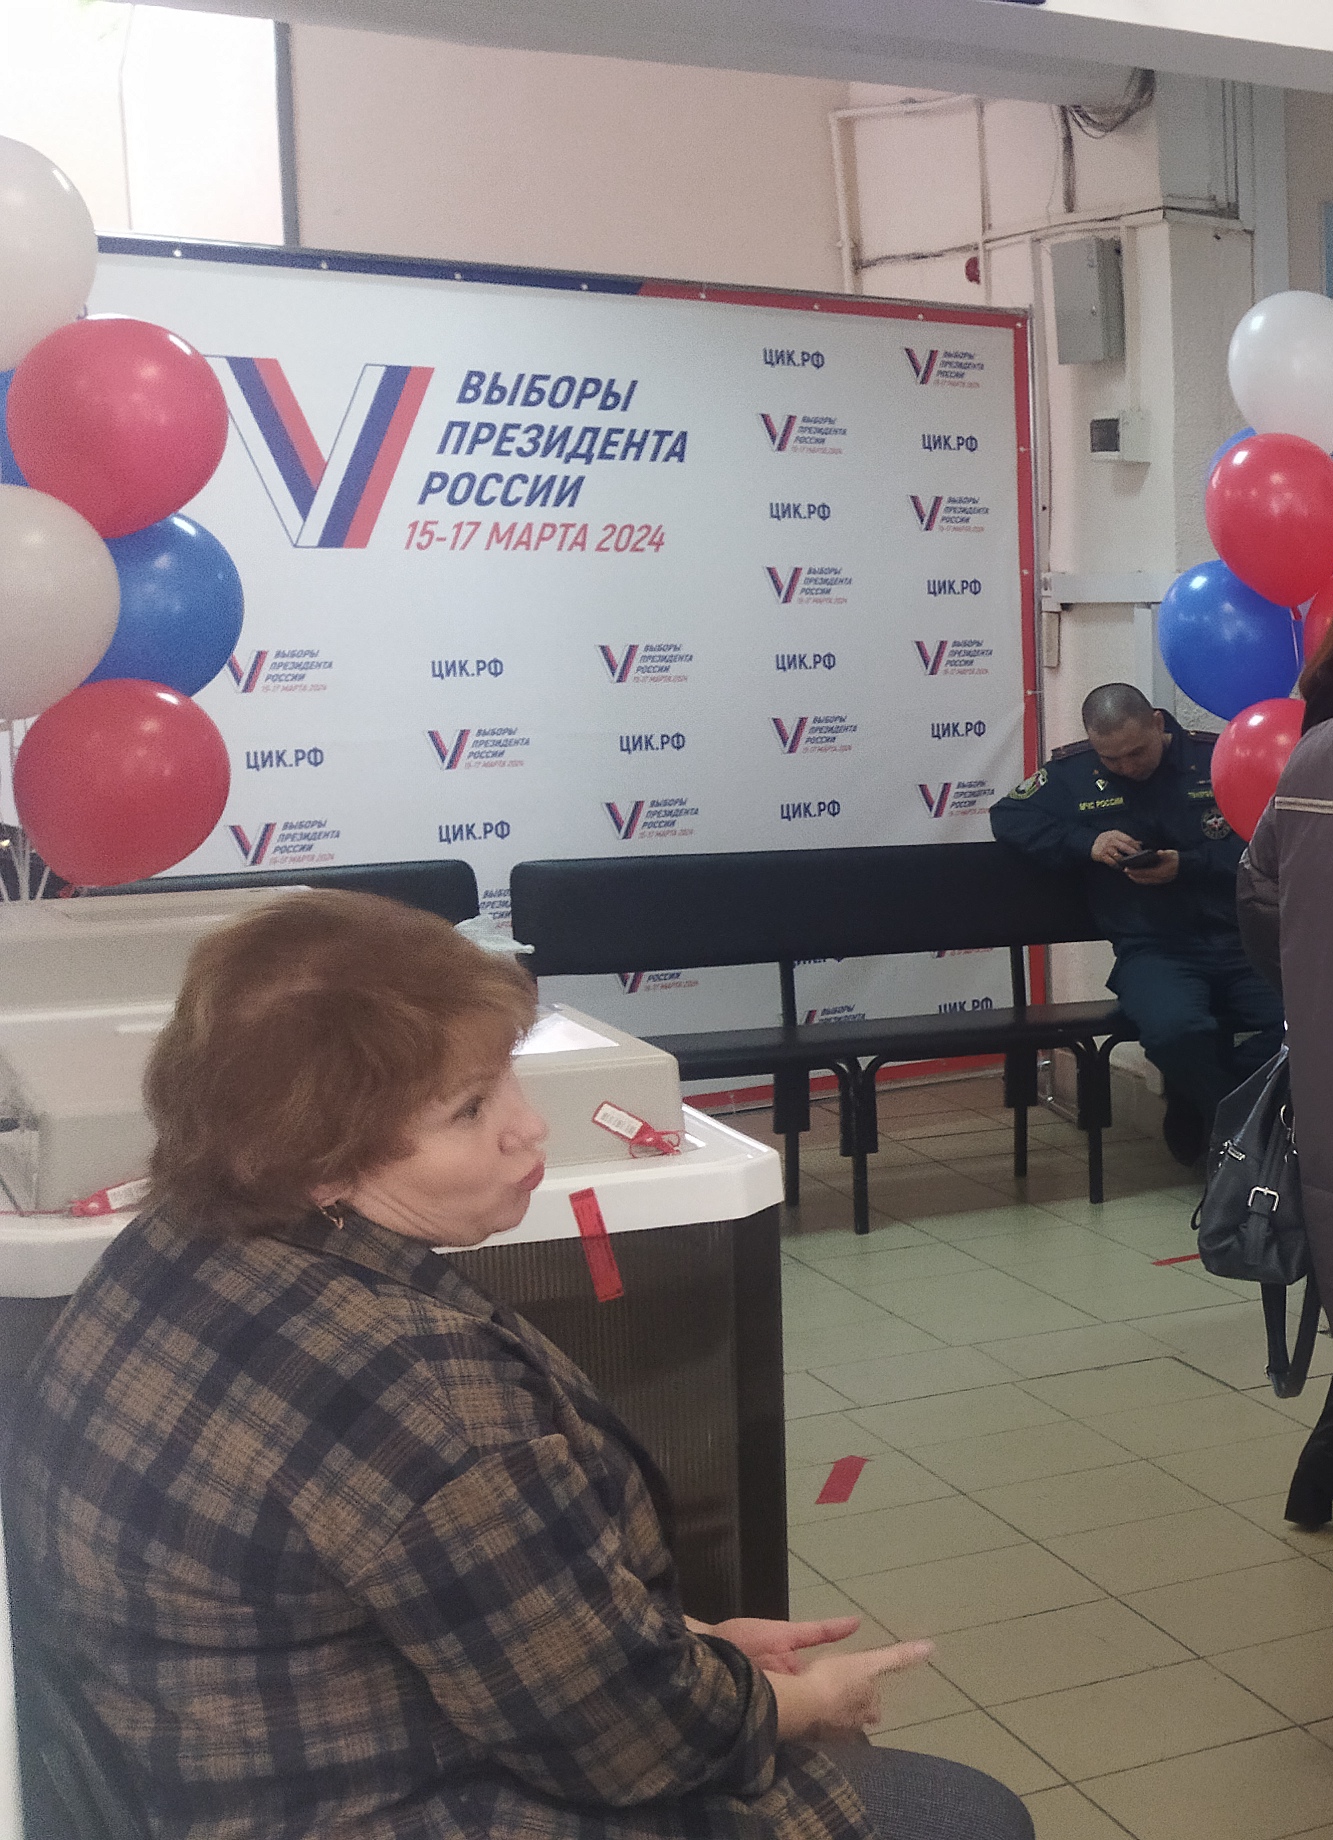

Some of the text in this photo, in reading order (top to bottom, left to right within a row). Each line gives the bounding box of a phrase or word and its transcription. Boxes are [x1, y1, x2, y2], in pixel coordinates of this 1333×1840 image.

[763, 348, 825, 369] ЦИК.РФ
[456, 370, 638, 412] ВЫБОРЫ
[437, 421, 688, 464] ПРЕЗИДЕНТА
[922, 434, 978, 452] ЦИК.РФ
[418, 471, 584, 508] РОССИИ
[769, 502, 831, 521] ЦИК.РФ
[404, 520, 665, 553] 15-17 МАРТА 2024
[926, 578, 982, 597] ЦИК.РФ
[274, 649, 319, 659] ВЫБОРЫ
[643, 643, 683, 652] ВЫБОРЫ
[269, 661, 333, 671] ПРЕЗИДЕНТА
[640, 654, 693, 664] ПРЕЗИДЕНТА
[775, 652, 836, 672] ЦИК.РФ
[265, 673, 306, 683] РОССИИ
[431, 658, 504, 680] ЦИК.РФ
[636, 665, 671, 674] РОССИИ
[476, 727, 518, 737] ВЫБОРЫ
[931, 720, 987, 740] ЦИК.РФ
[471, 737, 530, 749] ПРЕЗИДЕНТА
[619, 732, 686, 755] ЦИК.РФ
[245, 747, 325, 772] ЦИК.РФ
[467, 749, 505, 760] РОССИИ
[649, 798, 688, 808] ВЫБОРЫ
[780, 799, 841, 821] ЦИК.РФ
[646, 807, 699, 819] ПРЕЗИДЕНТА
[282, 820, 327, 831] ВЫБОРЫ
[438, 820, 511, 845] ЦИК.РФ
[642, 819, 677, 830] РОССИИ
[277, 830, 341, 842] ПРЕЗИДЕНТА
[272, 843, 314, 854] РОССИИ
[938, 996, 993, 1014] ЦИКРФ
